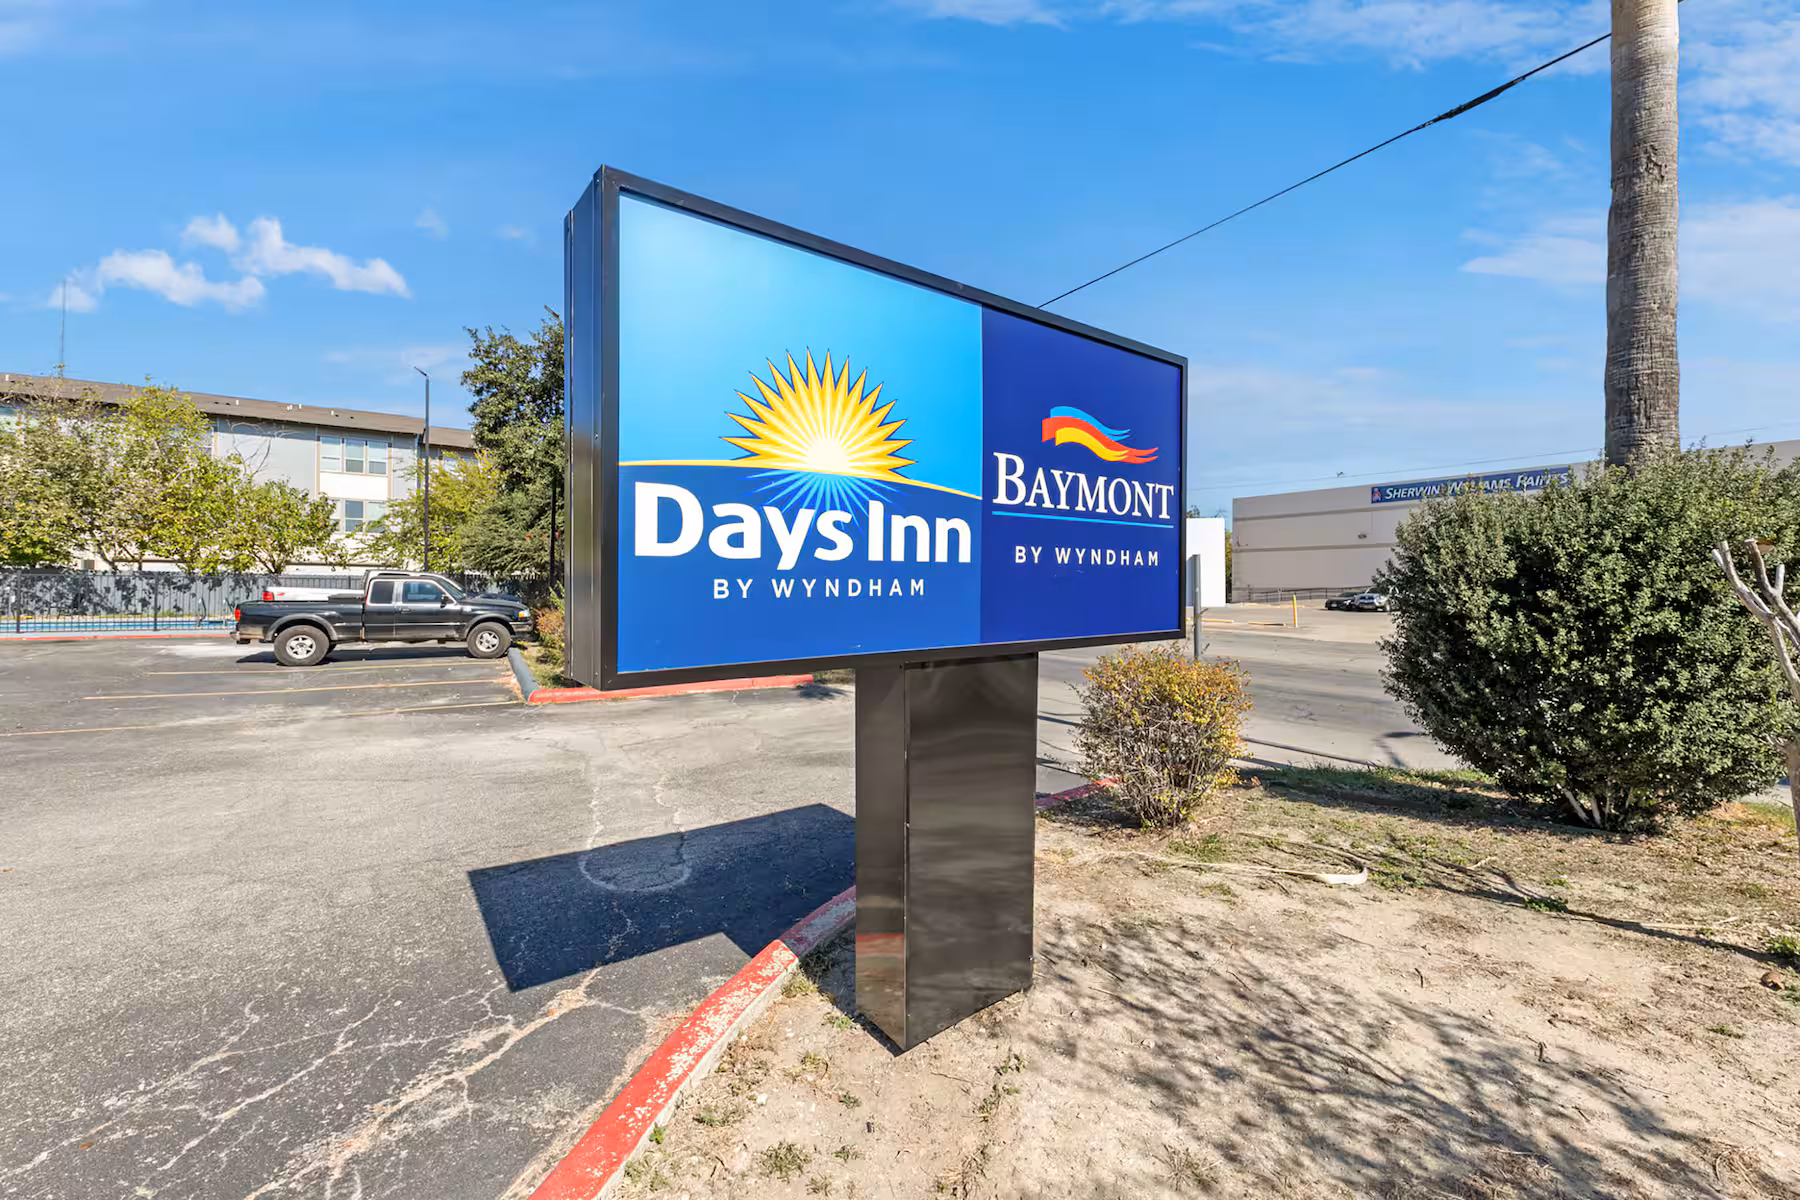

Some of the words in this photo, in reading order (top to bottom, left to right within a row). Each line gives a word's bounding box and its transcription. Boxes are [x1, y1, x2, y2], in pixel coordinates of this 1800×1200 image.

[992, 452, 1174, 519] BAYMONT
[1385, 485, 1440, 499] SHERWIN
[1448, 478, 1511, 495] WLAMS
[1516, 472, 1569, 488] PAINS
[635, 481, 853, 571] Days
[868, 500, 971, 563] Inn
[1015, 545, 1042, 564] BY
[1055, 547, 1159, 567] WYNDHAM
[713, 578, 753, 599] BY
[771, 578, 925, 598] WYNDHAM
